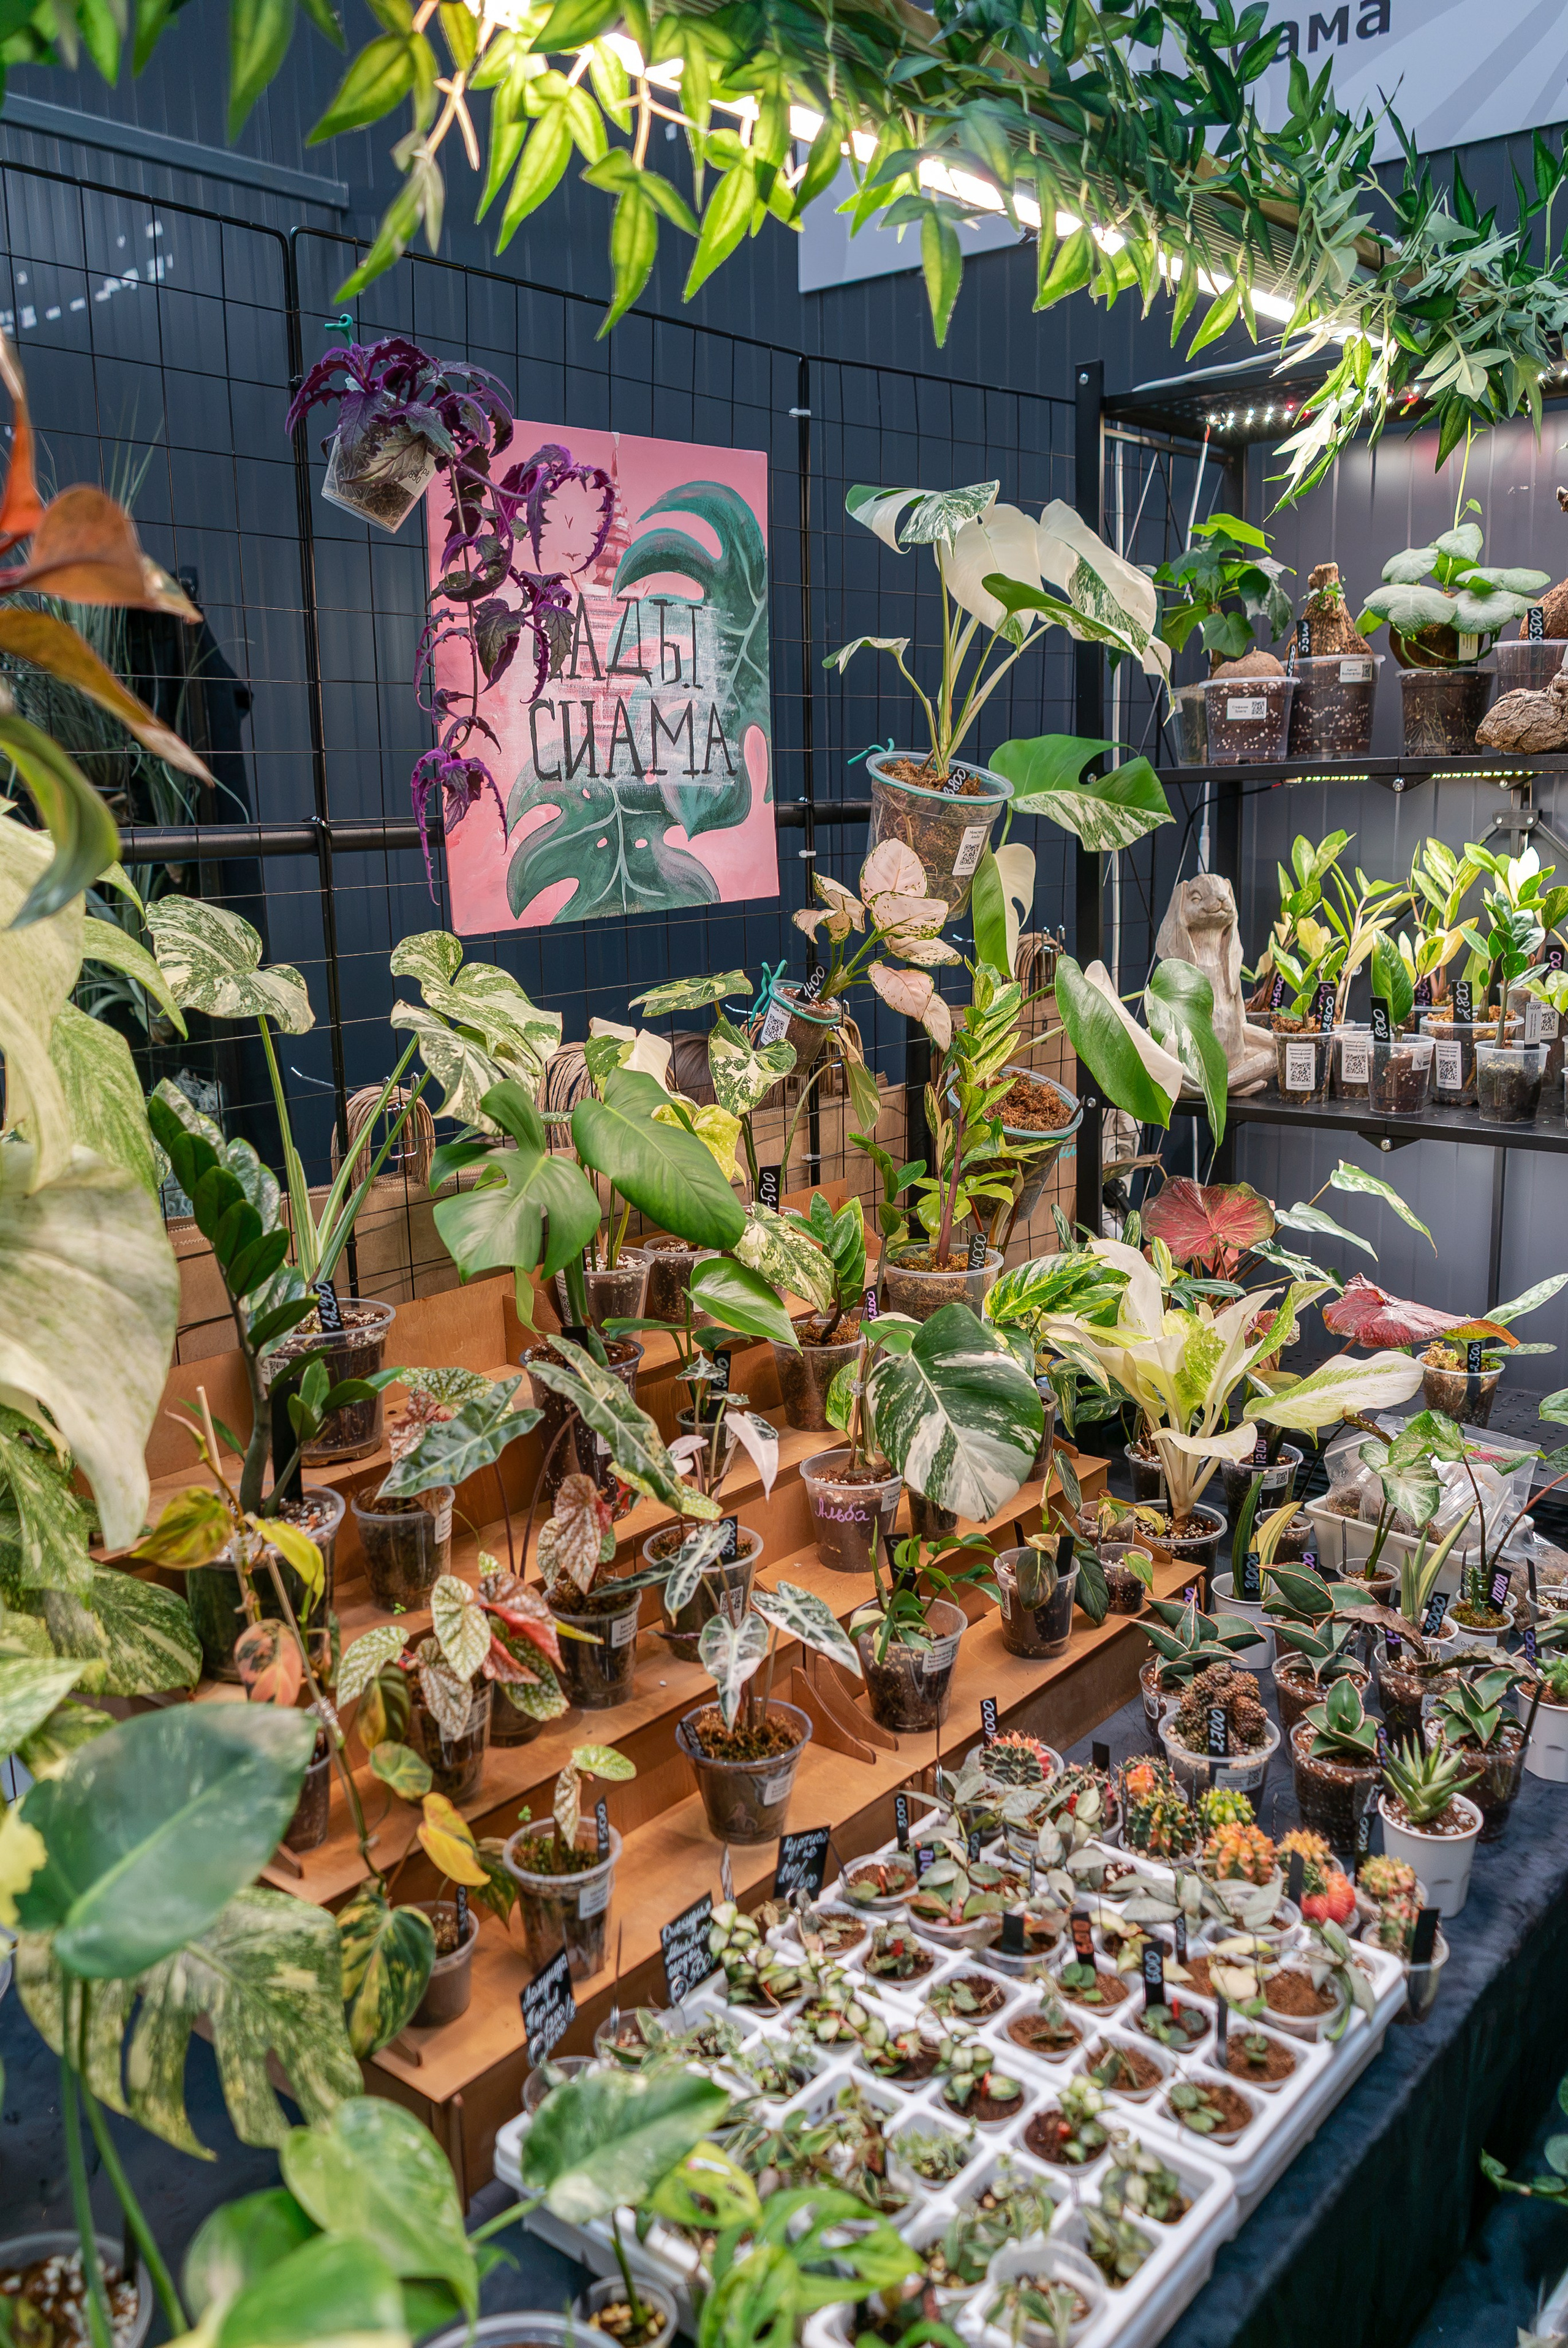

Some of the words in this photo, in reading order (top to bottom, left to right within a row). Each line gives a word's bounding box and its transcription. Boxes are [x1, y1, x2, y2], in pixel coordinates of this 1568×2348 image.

[533, 592, 704, 689] АДЫ
[528, 694, 739, 782] СИАМА
[804, 965, 824, 998] 1400
[1457, 981, 1471, 1021] 2800
[1373, 1009, 1388, 1038] 800
[970, 1234, 987, 1269] 4000
[867, 1291, 878, 1320] 1200
[1469, 1343, 1480, 1372] 2500
[815, 1497, 870, 1522] Альба
[1245, 1553, 1259, 1589] 3000
[1491, 1573, 1509, 1604] 1000
[1425, 1596, 1446, 1634] 3000
[983, 1700, 997, 1738] 1000
[1145, 1950, 1162, 1985] 600
